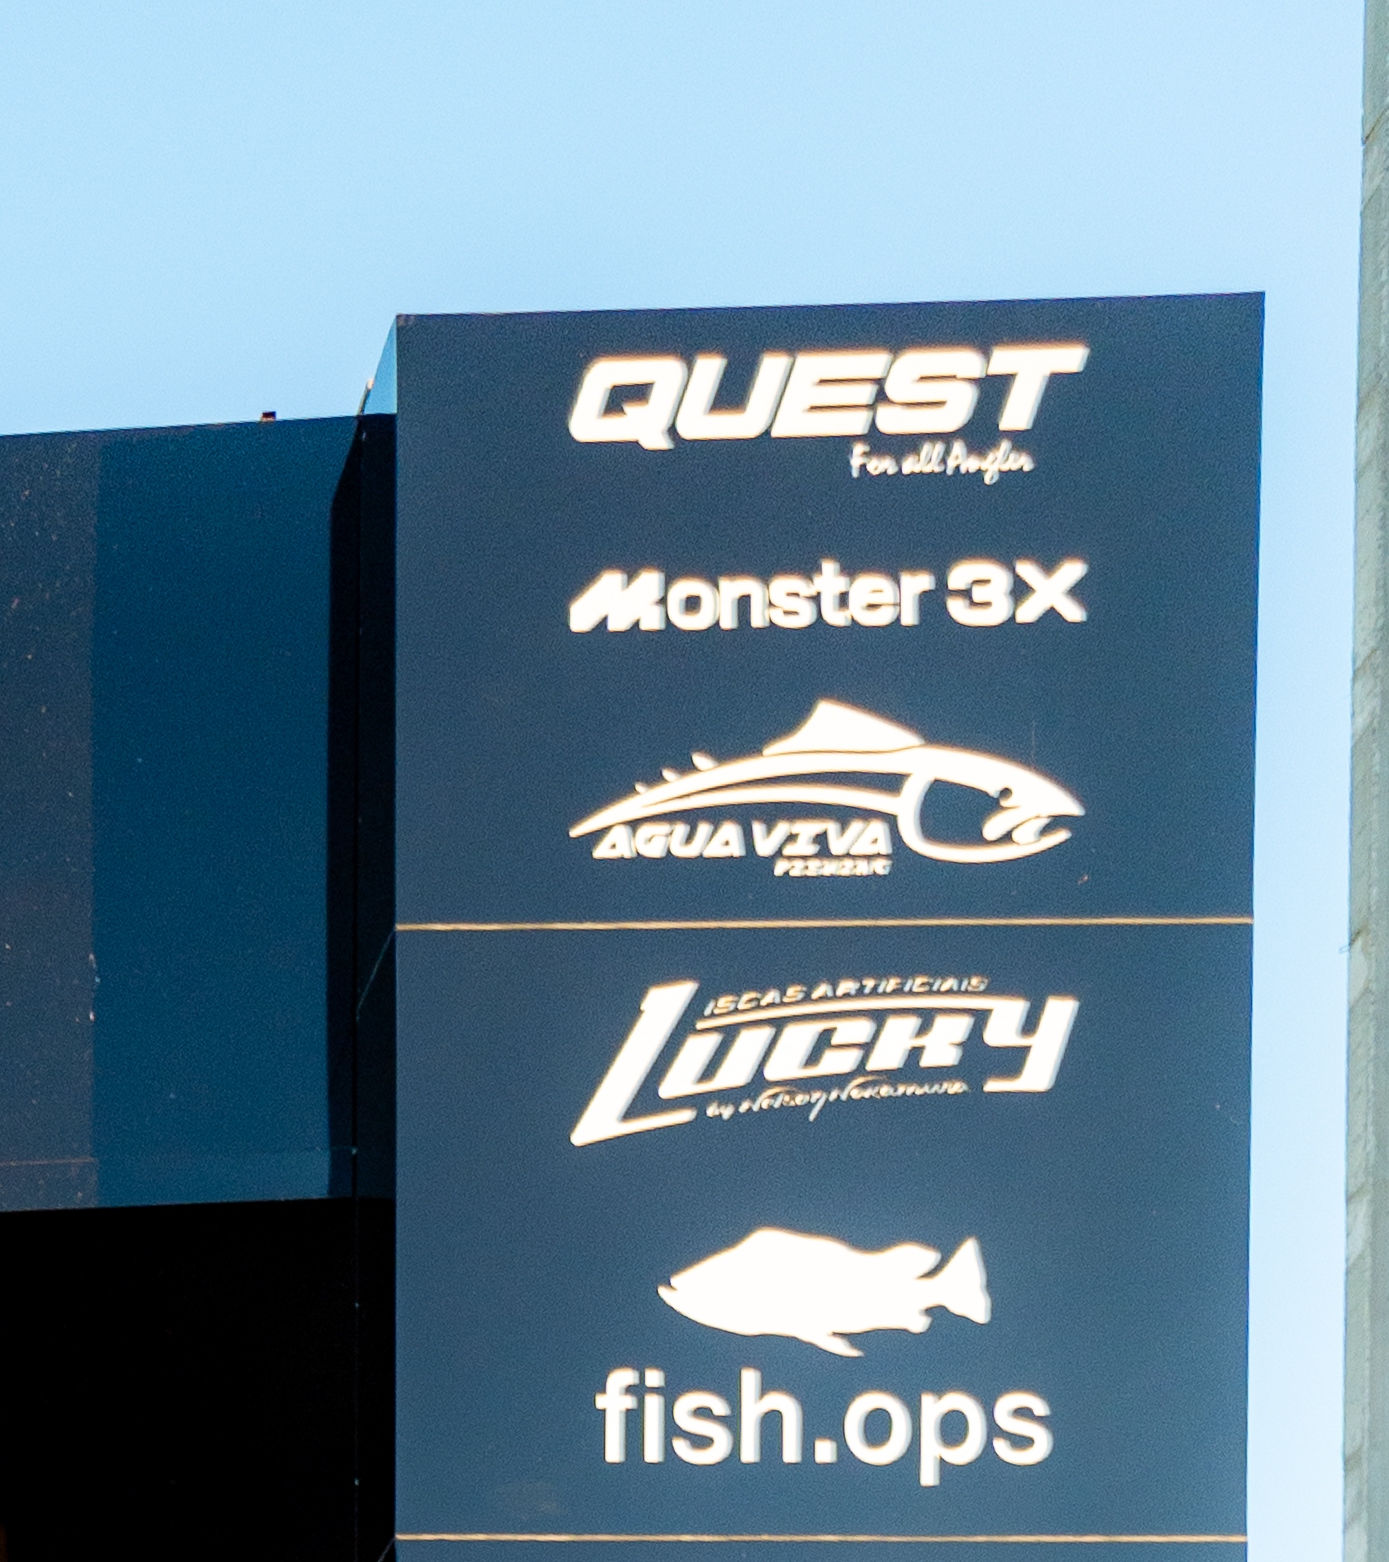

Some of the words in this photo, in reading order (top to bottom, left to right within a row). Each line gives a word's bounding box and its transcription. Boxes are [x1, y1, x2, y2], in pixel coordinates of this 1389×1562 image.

[569, 341, 1090, 450] QUEST
[569, 559, 936, 633] Monster
[945, 558, 1089, 628] 3X
[592, 821, 747, 859] AGUA
[750, 820, 894, 858] VIVA
[594, 1367, 1055, 1487] fish.ops
